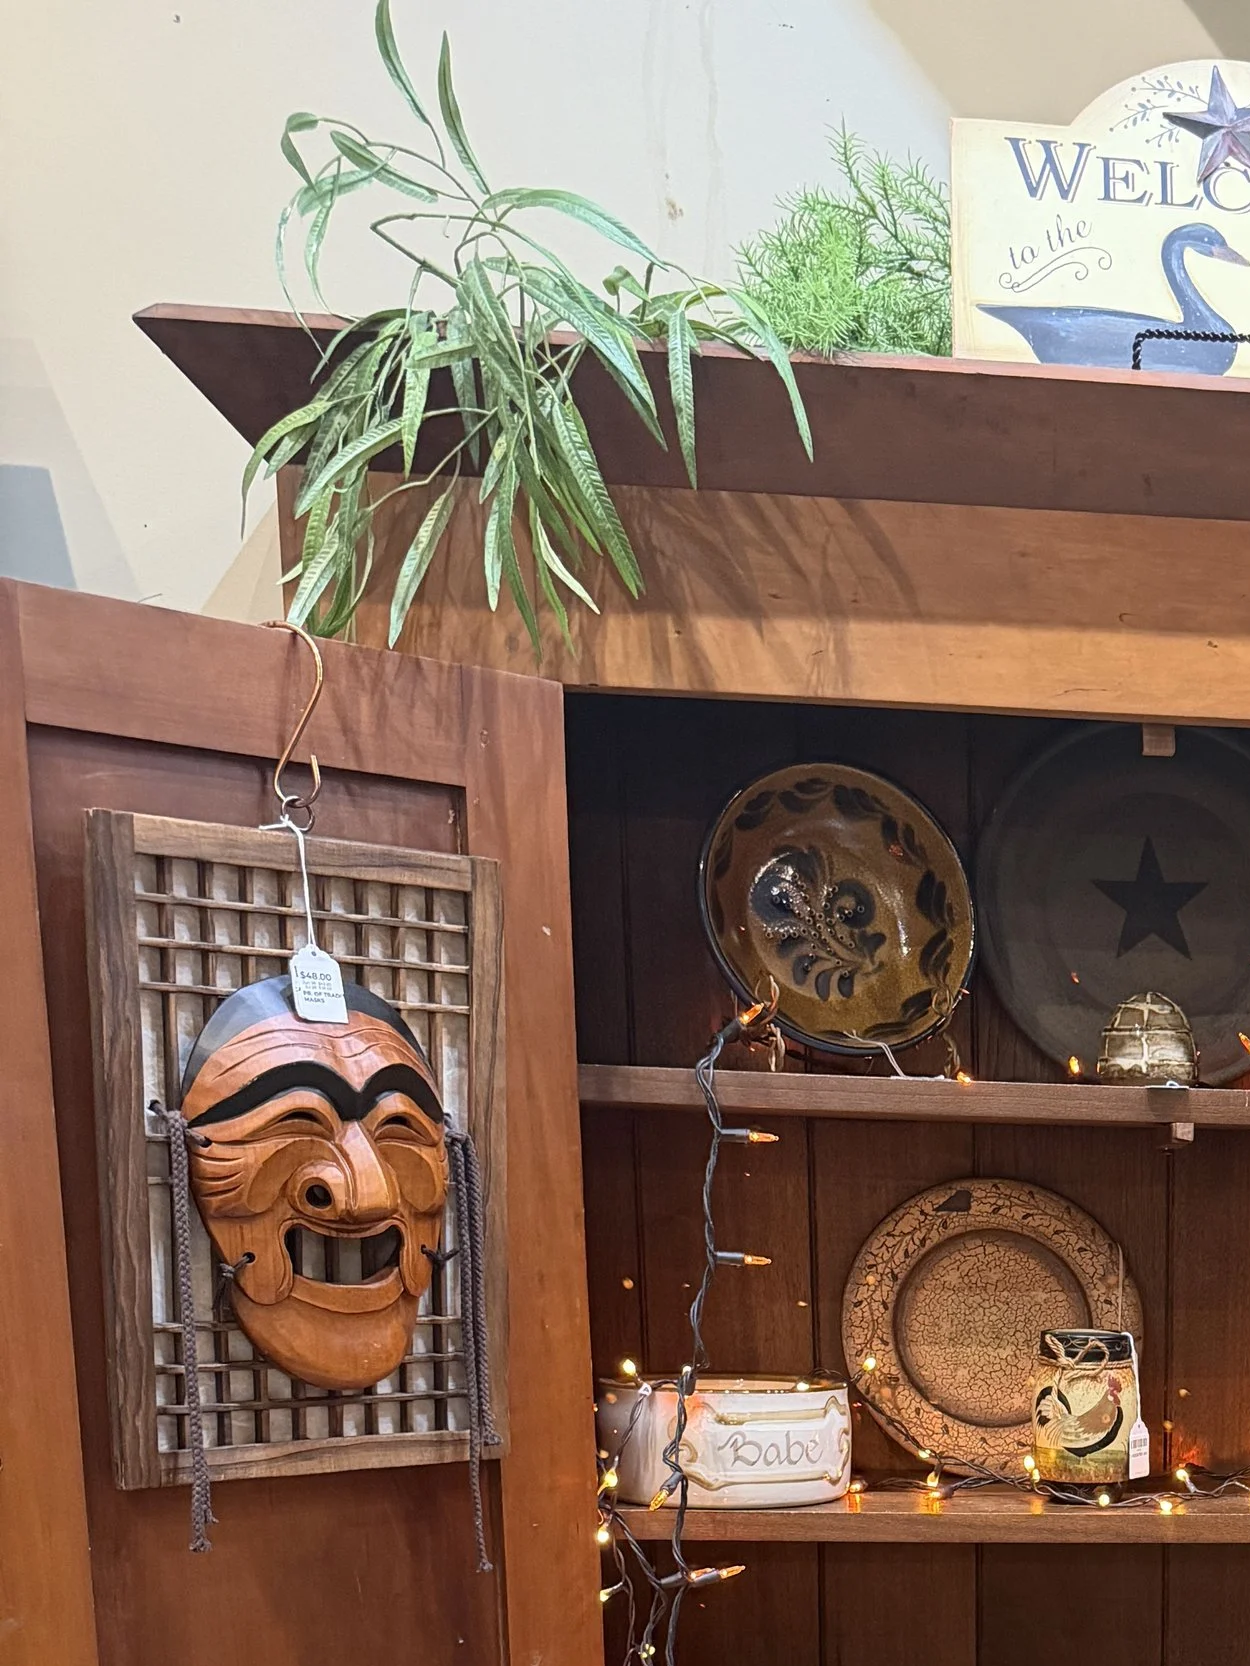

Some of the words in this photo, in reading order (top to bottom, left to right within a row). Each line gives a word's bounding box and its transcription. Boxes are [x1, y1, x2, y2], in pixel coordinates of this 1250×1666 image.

[1009, 246, 1040, 270] to
[1046, 213, 1093, 253] the
[300, 970, 332, 982] $48.00
